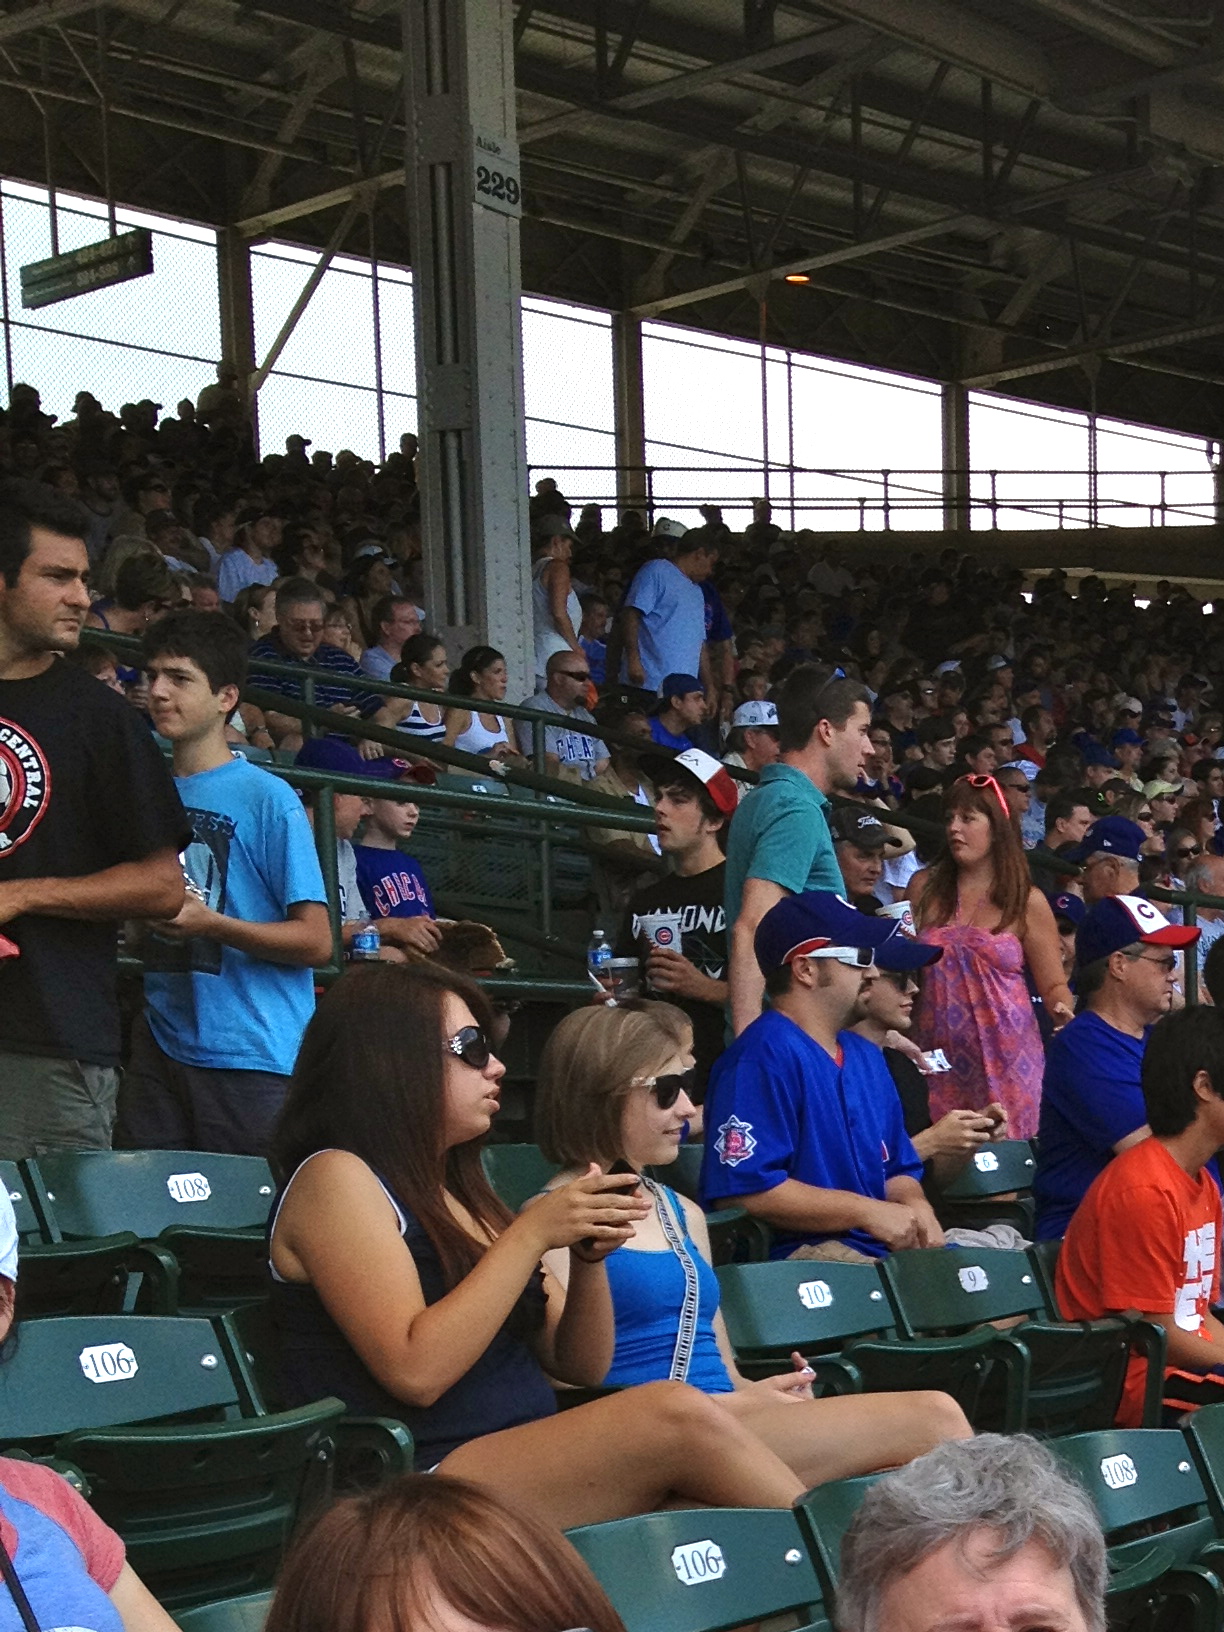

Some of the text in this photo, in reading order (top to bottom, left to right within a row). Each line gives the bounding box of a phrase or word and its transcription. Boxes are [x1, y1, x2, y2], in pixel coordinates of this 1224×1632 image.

[476, 165, 520, 205] 229
[1137, 903, 1155, 919] C
[173, 1178, 207, 1199] 108
[967, 1270, 977, 1289] 9
[808, 1284, 825, 1305] 10
[88, 1348, 132, 1379] 106
[1109, 1459, 1134, 1486] 108
[680, 1546, 721, 1580] 106
